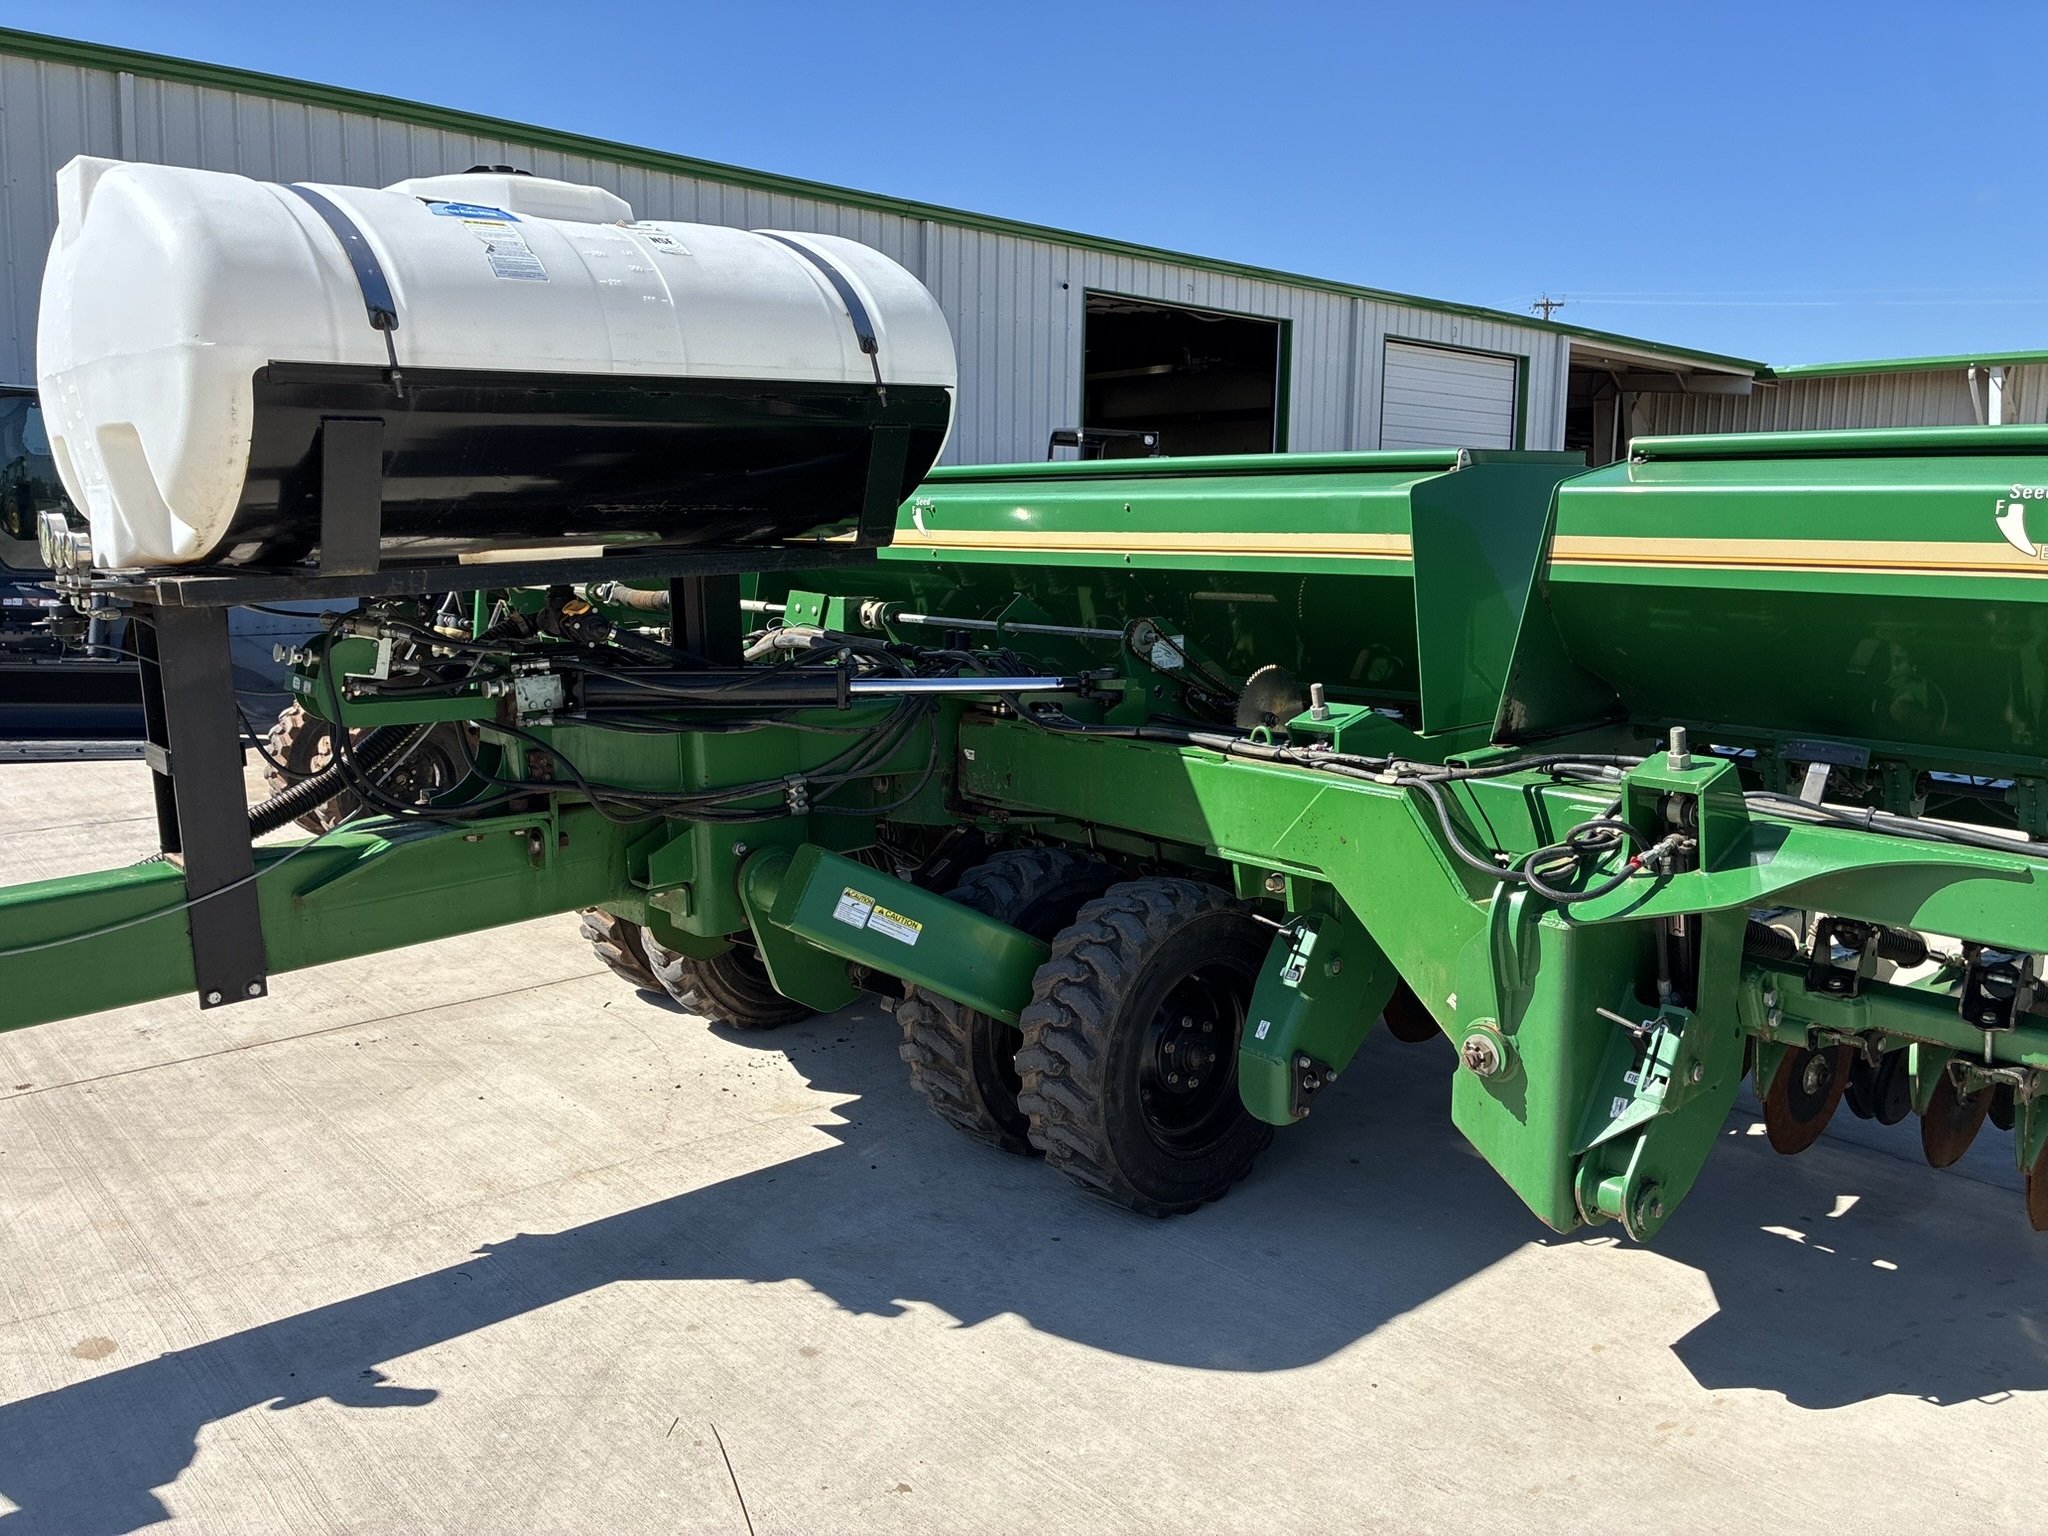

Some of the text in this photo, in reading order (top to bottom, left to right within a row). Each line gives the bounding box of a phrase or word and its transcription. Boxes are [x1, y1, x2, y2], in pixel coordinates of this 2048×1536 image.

[648, 236, 675, 245] NSF
[2010, 484, 2048, 499] See
[915, 497, 931, 505] Seed
[849, 892, 873, 905] CAUTION
[885, 909, 918, 929] CAUTION
